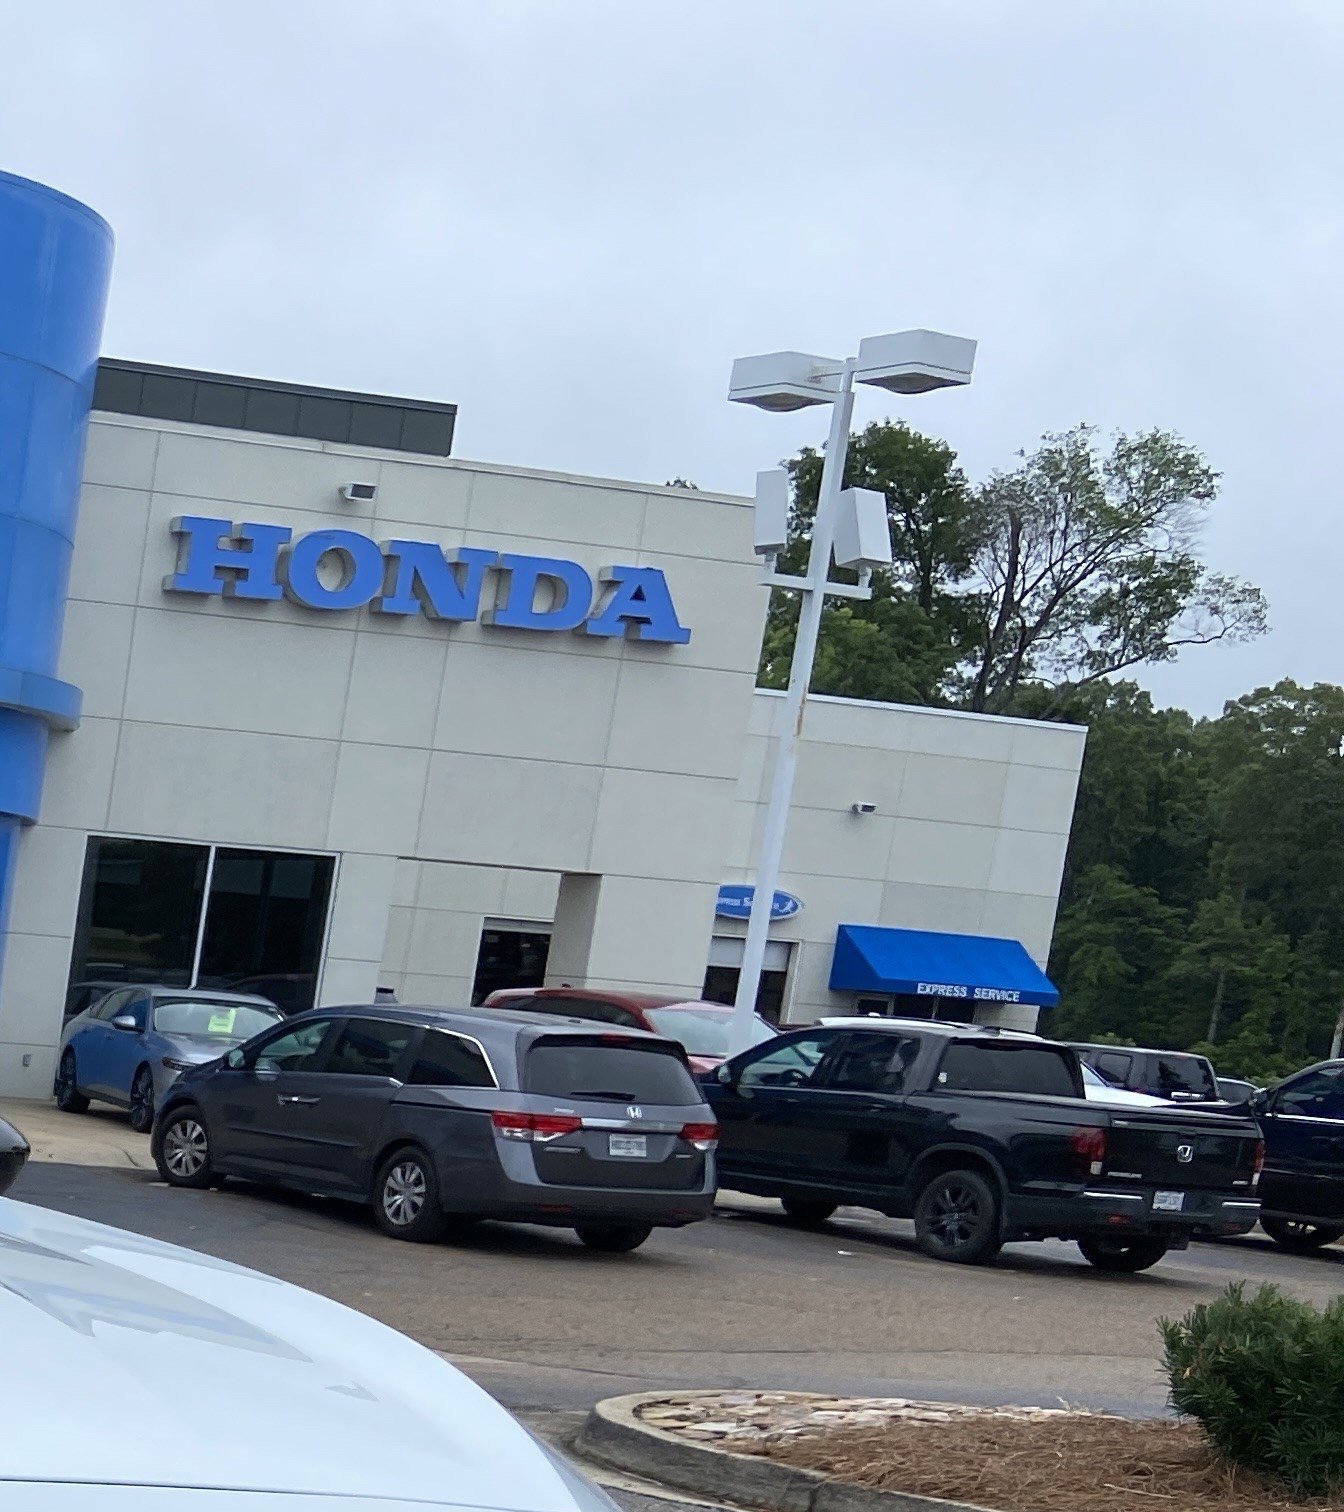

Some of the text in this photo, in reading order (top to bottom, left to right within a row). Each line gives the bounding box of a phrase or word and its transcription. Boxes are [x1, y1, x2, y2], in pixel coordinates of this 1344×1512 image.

[163, 515, 692, 645] HONDA
[916, 982, 1021, 1003] EXPRESS SERVICE
